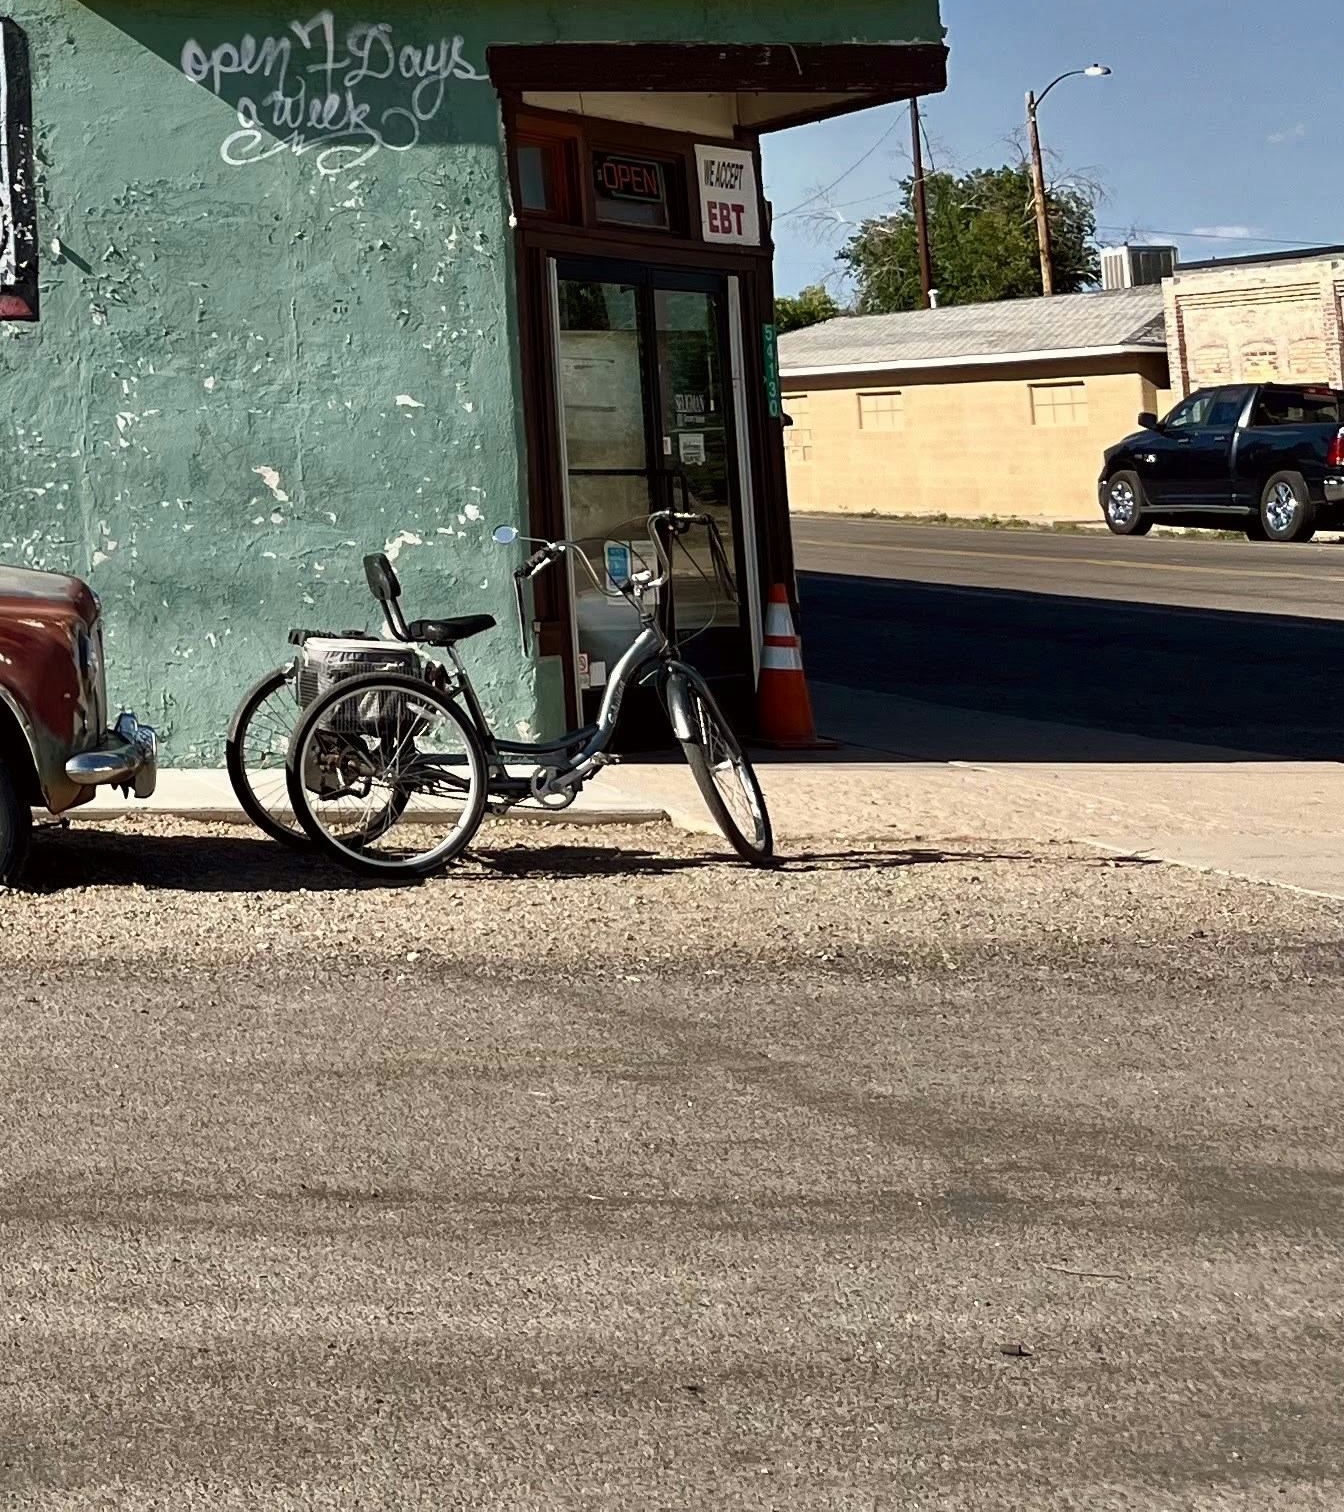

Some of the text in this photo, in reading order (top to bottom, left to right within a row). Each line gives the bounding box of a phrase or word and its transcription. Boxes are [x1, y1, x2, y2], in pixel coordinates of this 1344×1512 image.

[343, 23, 489, 120] Days
[603, 163, 658, 194] OPEN
[704, 159, 744, 191] WE ACCEPT
[707, 200, 745, 236] EBT
[764, 324, 778, 418] 54130
